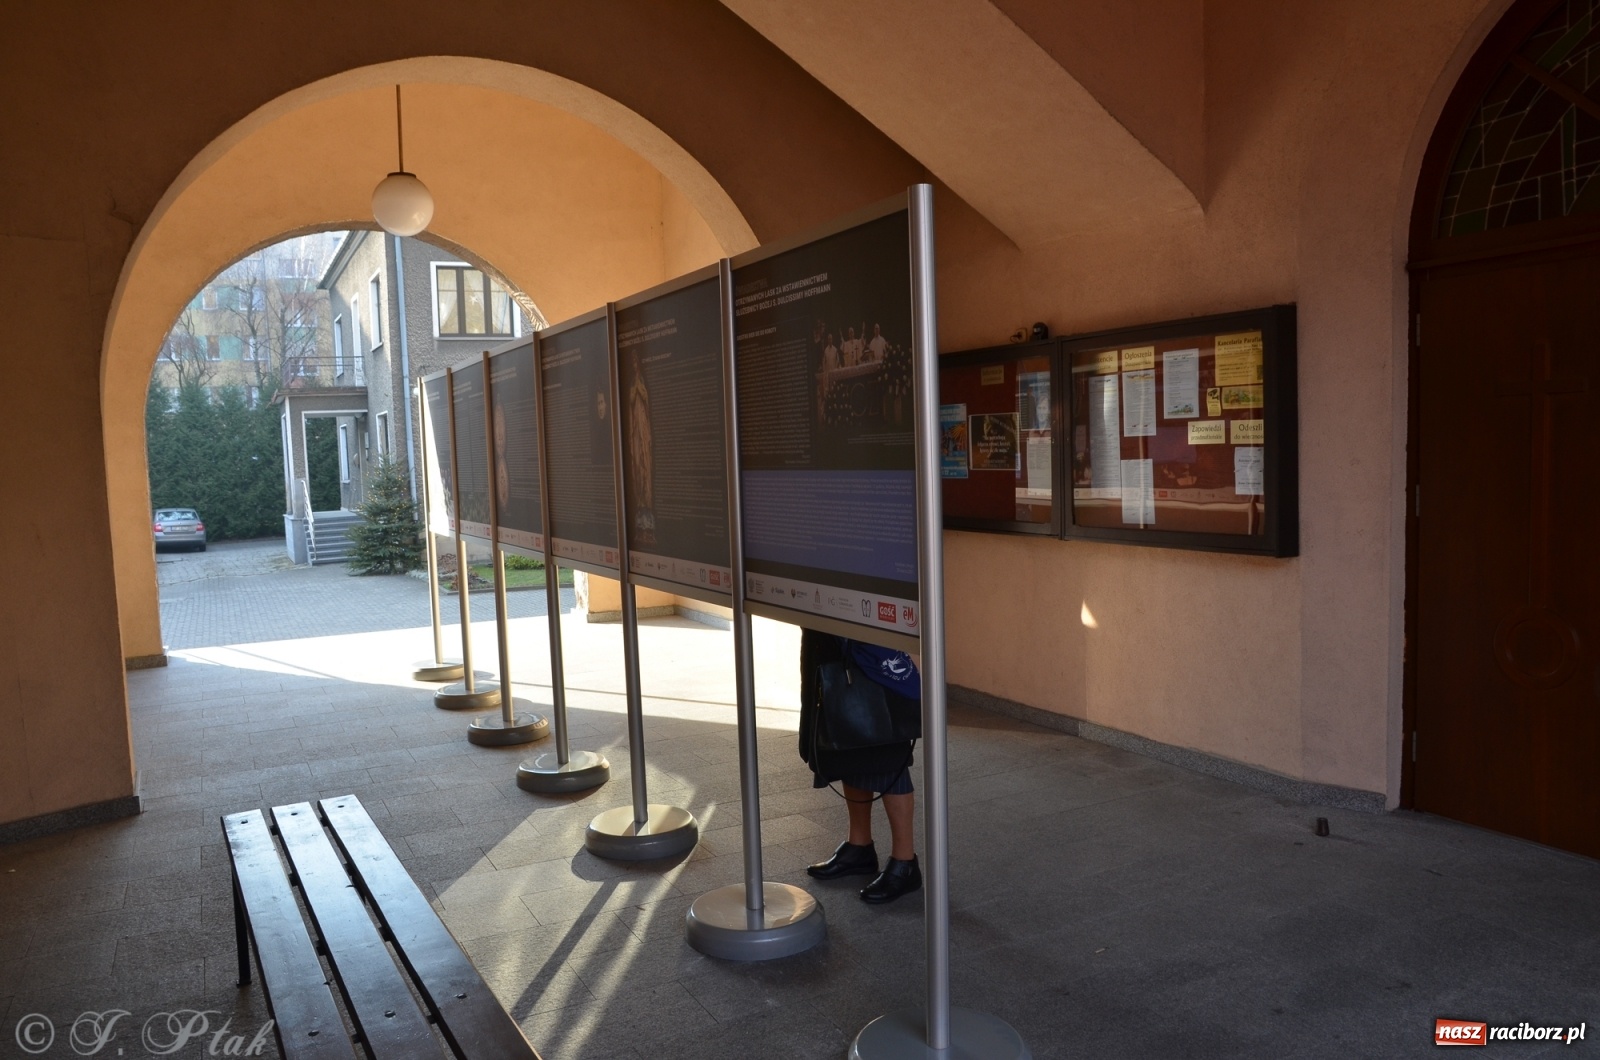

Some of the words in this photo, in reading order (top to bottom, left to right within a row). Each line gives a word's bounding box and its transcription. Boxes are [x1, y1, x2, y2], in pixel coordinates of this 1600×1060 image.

[803, 283, 831, 299] HOFFMANN
[1217, 338, 1243, 347] Kancelaria
[1243, 336, 1262, 344] Parafia
[1191, 424, 1222, 434] Zapowiedzi
[1238, 423, 1263, 432] Odeszli
